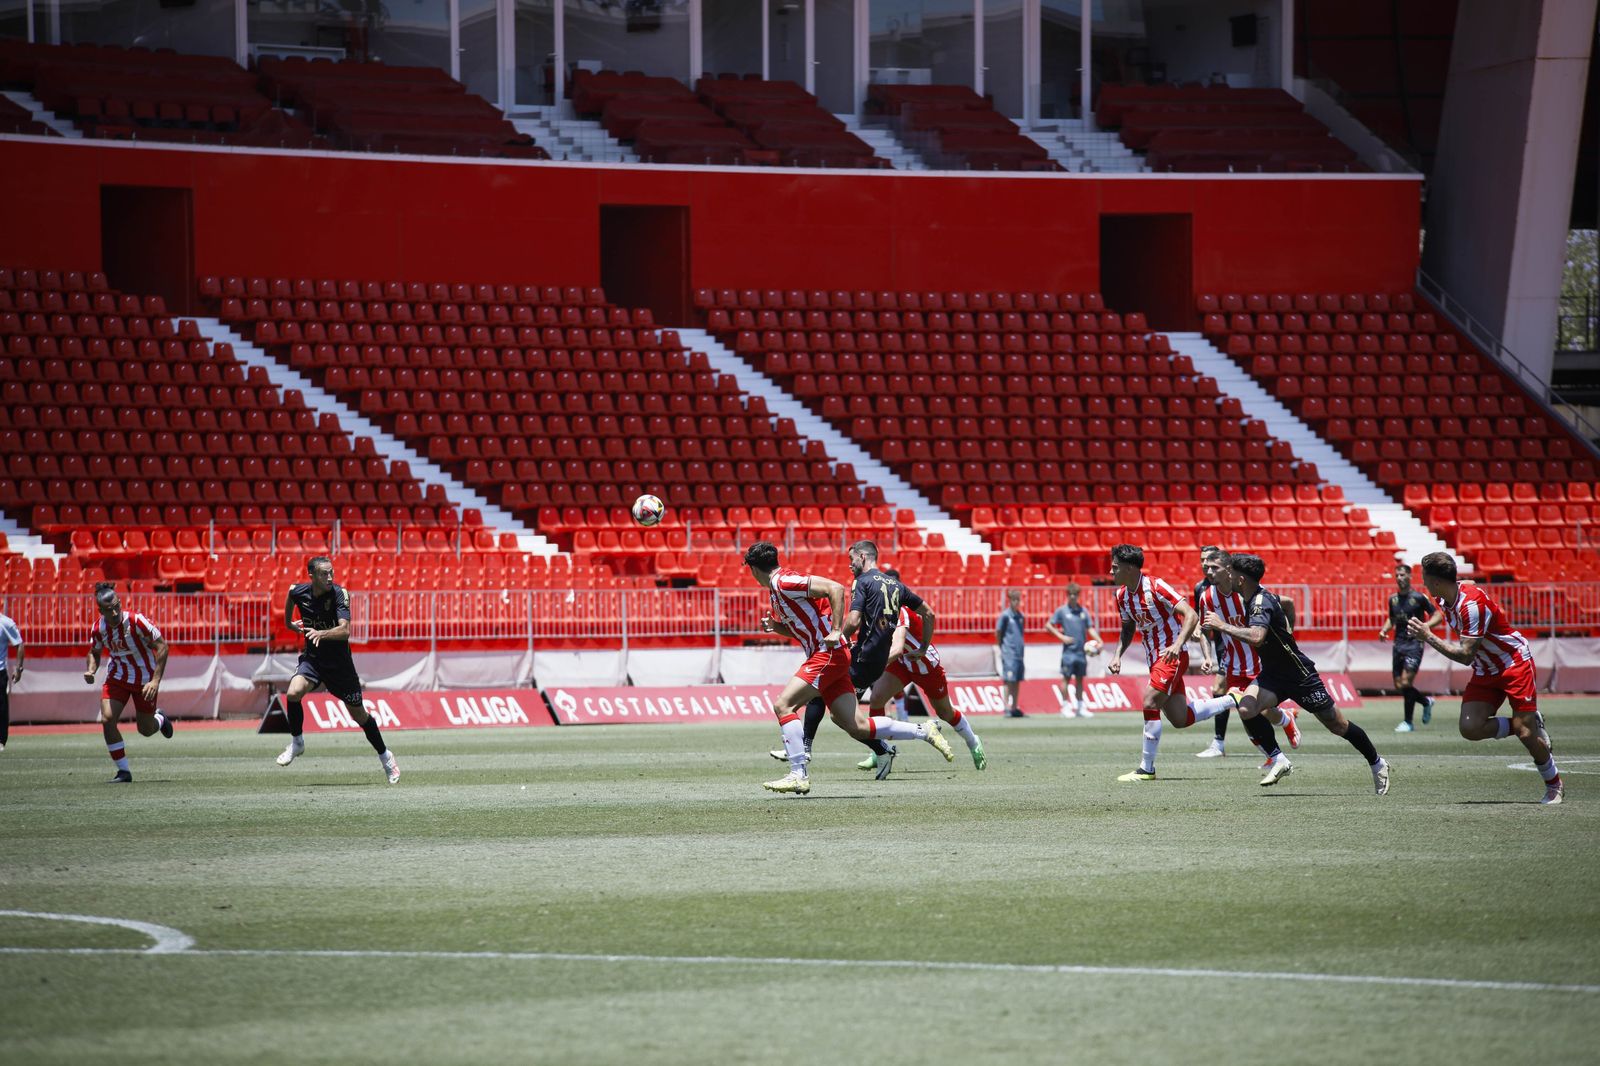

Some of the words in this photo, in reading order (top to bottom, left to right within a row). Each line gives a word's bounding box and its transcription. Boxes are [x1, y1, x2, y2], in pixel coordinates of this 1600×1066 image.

[307, 699, 401, 729] LALGA
[440, 696, 529, 725] LALIGA
[583, 690, 778, 716] COSTADEALMERÍ
